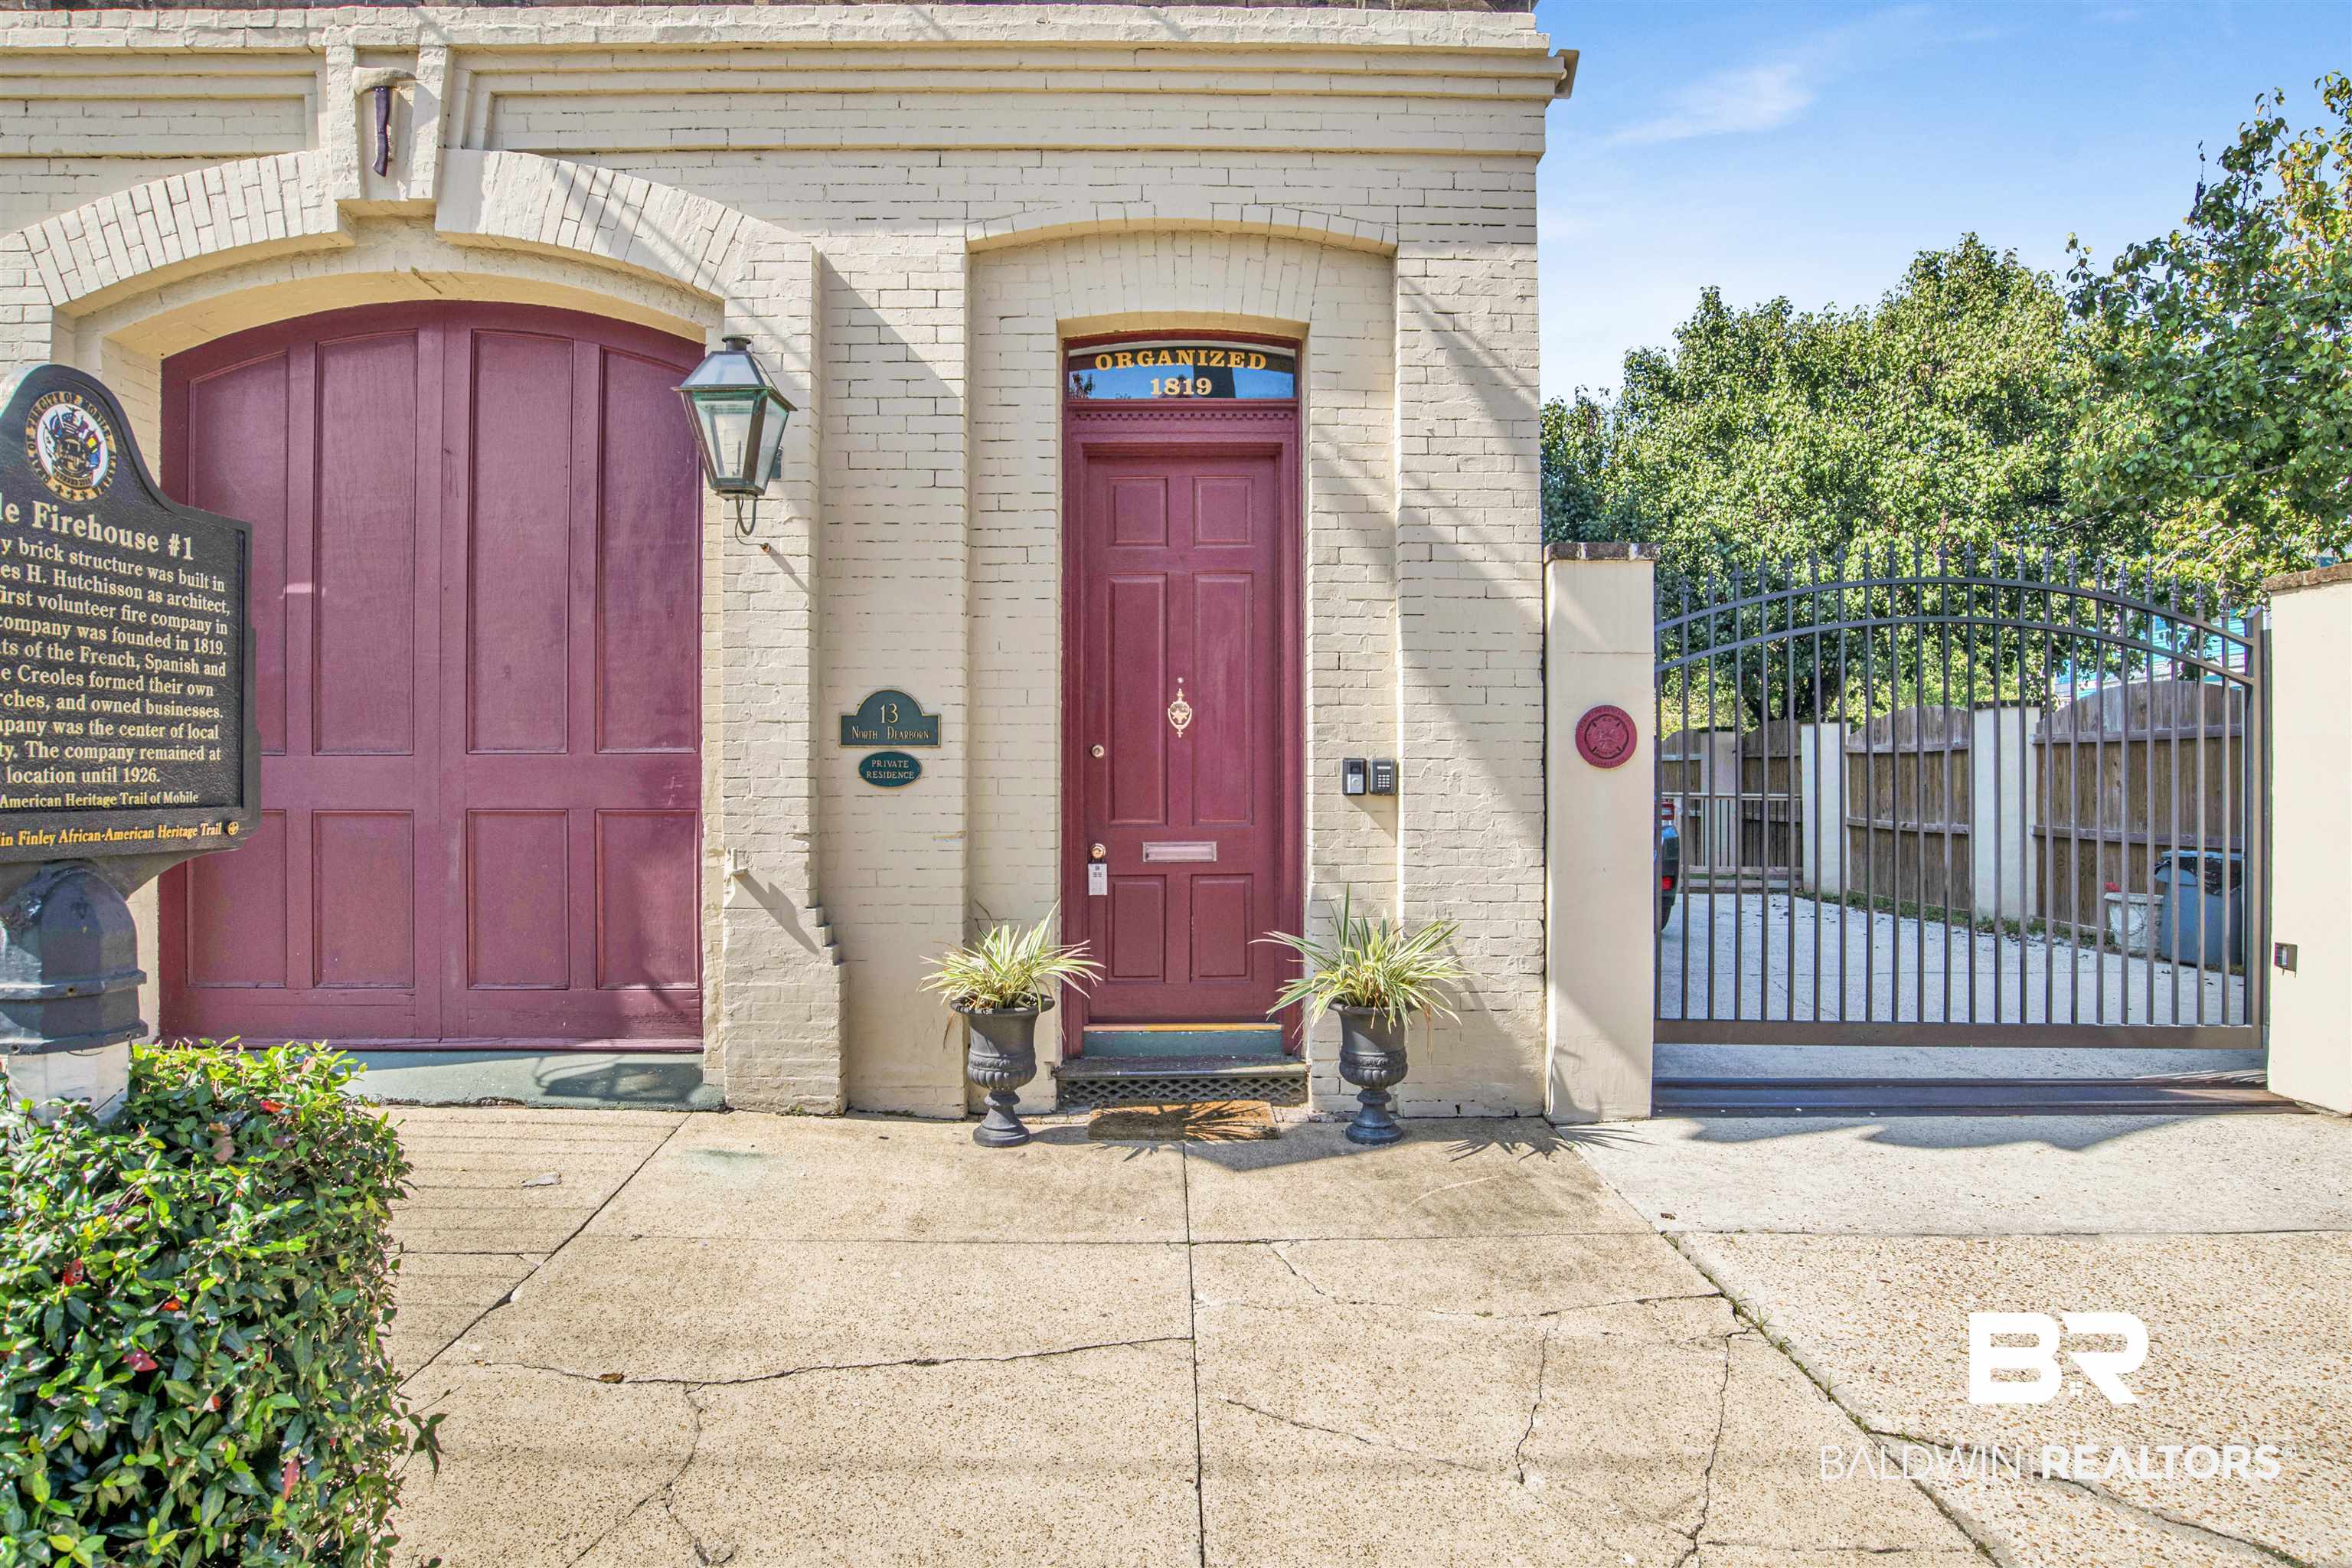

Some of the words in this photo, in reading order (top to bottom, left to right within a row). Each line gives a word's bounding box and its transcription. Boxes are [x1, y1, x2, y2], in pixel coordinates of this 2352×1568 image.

[1094, 349, 1268, 371] ORGANIZED
[1150, 377, 1213, 396] 1819
[32, 500, 159, 554] Firehouse
[168, 532, 194, 560] #1
[18, 537, 65, 563] brick
[70, 550, 143, 577] structure
[147, 565, 175, 583] was
[178, 569, 210, 590] built
[212, 575, 226, 593] in
[26, 563, 47, 584] H.
[53, 567, 142, 600] Hutchisson
[147, 587, 163, 603] as
[167, 591, 230, 616] architect,
[37, 593, 117, 619] volunteer
[120, 604, 147, 623] fire
[151, 612, 213, 635] company
[216, 619, 228, 635] in
[77, 626, 107, 641] was
[112, 626, 172, 649] founded
[176, 634, 189, 651] in
[194, 637, 227, 656] 1819.
[24, 640, 44, 658] of
[47, 642, 75, 662] the
[80, 645, 141, 670] French,
[145, 653, 199, 675] Spanish
[204, 662, 227, 677] and
[18, 664, 84, 687] Creoles
[89, 671, 145, 692] formed
[149, 678, 185, 695] their
[187, 683, 214, 697] own
[0, 688, 51, 711] ches,
[56, 694, 87, 711] and
[91, 698, 141, 714] owned
[145, 699, 224, 718] businesses.
[880, 703, 899, 724] 13
[52, 721, 84, 735] was
[88, 718, 114, 736] the
[119, 724, 166, 737] center
[170, 722, 185, 738] of
[188, 723, 220, 740] local
[24, 740, 60, 759] The
[64, 746, 136, 763] company
[140, 745, 205, 761] remained
[209, 746, 222, 761] at
[7, 766, 76, 783] location
[81, 766, 118, 783] until
[122, 766, 161, 783] 1926.
[866, 770, 915, 779] RESIDENCE
[871, 760, 909, 768] PRIVATE
[65, 793, 118, 808] Heritage
[119, 792, 148, 805] Trail
[150, 792, 161, 805] of
[163, 791, 199, 804] Mobile
[18, 828, 56, 847] Finley
[58, 826, 155, 844] African-American
[158, 823, 198, 839] Heritage
[200, 822, 222, 837] Trail
